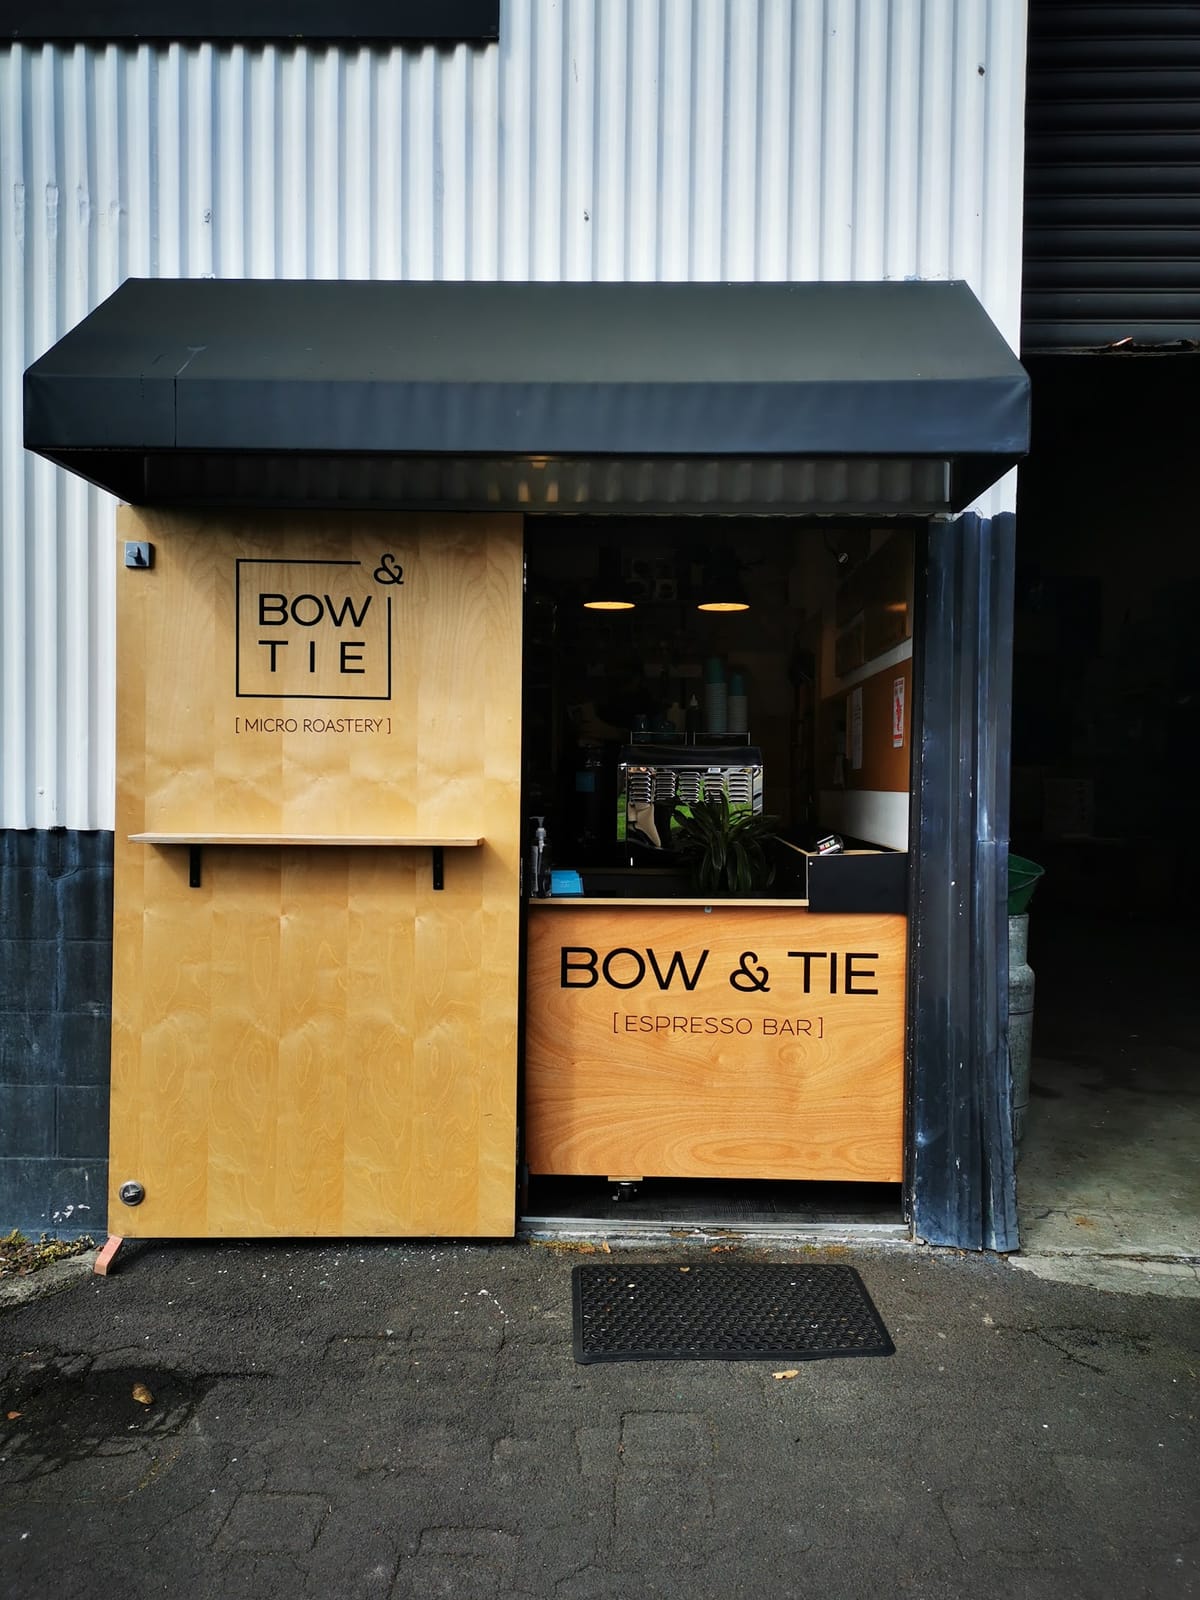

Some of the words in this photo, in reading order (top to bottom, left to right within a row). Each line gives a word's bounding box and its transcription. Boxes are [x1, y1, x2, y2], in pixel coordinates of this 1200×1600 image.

[373, 553, 403, 584] &
[259, 593, 372, 627] BOW
[258, 640, 365, 673] TIE
[560, 946, 709, 991] BOW
[730, 951, 771, 992] &
[788, 952, 879, 995] TIE
